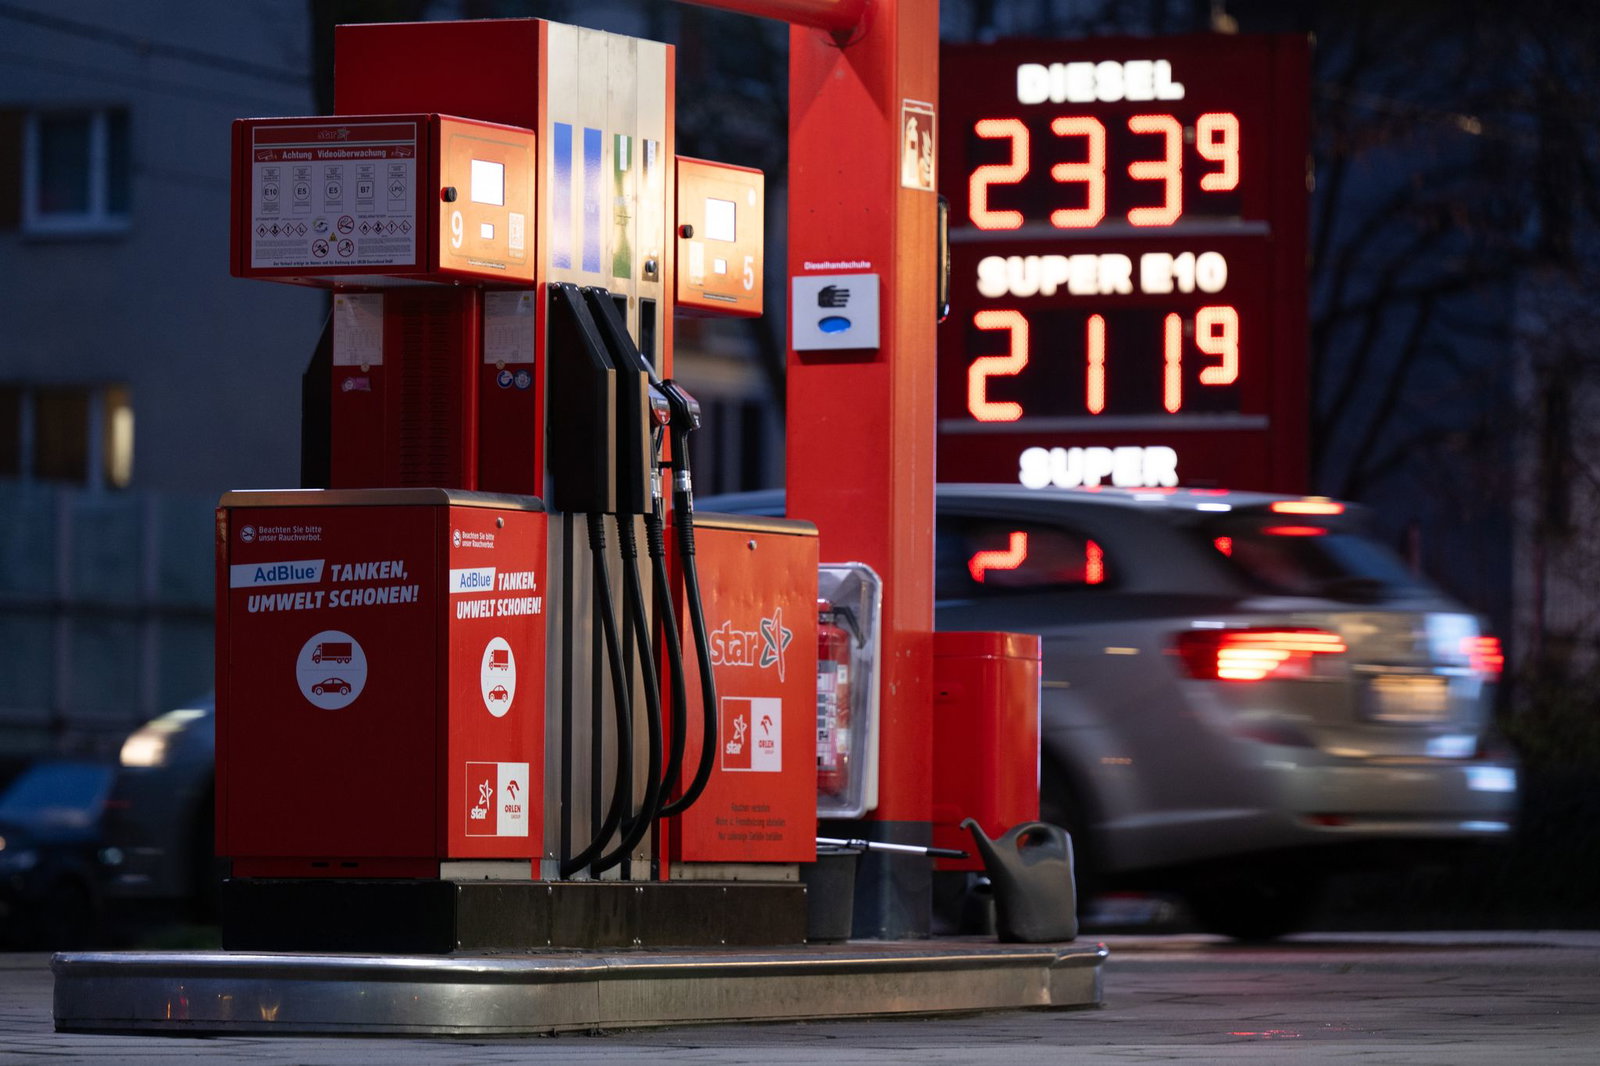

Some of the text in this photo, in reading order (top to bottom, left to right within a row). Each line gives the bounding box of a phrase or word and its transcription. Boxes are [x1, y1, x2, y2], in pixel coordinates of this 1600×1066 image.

[1017, 59, 1185, 104] DIESEL
[282, 149, 386, 160] Achtung Videoüberwachung
[452, 210, 463, 248] 9
[744, 256, 754, 290] 5
[804, 260, 871, 270] Dieselhandschuhe
[977, 251, 1227, 298] SUPER E10
[1018, 446, 1179, 490] SUPER
[258, 526, 290, 534] Beachten
[292, 525, 303, 533] Sie
[278, 534, 322, 542] Rauchverbot.
[331, 560, 408, 582] TANKEN,
[460, 571, 536, 592] AdBlue TANKEN,
[248, 585, 420, 613] UMWELT SCHONEN!
[456, 596, 542, 620] UMWELT SCHONEN!
[709, 620, 759, 666] star
[726, 740, 742, 754] star
[470, 805, 488, 820] star
[504, 804, 521, 813] ORLEN
